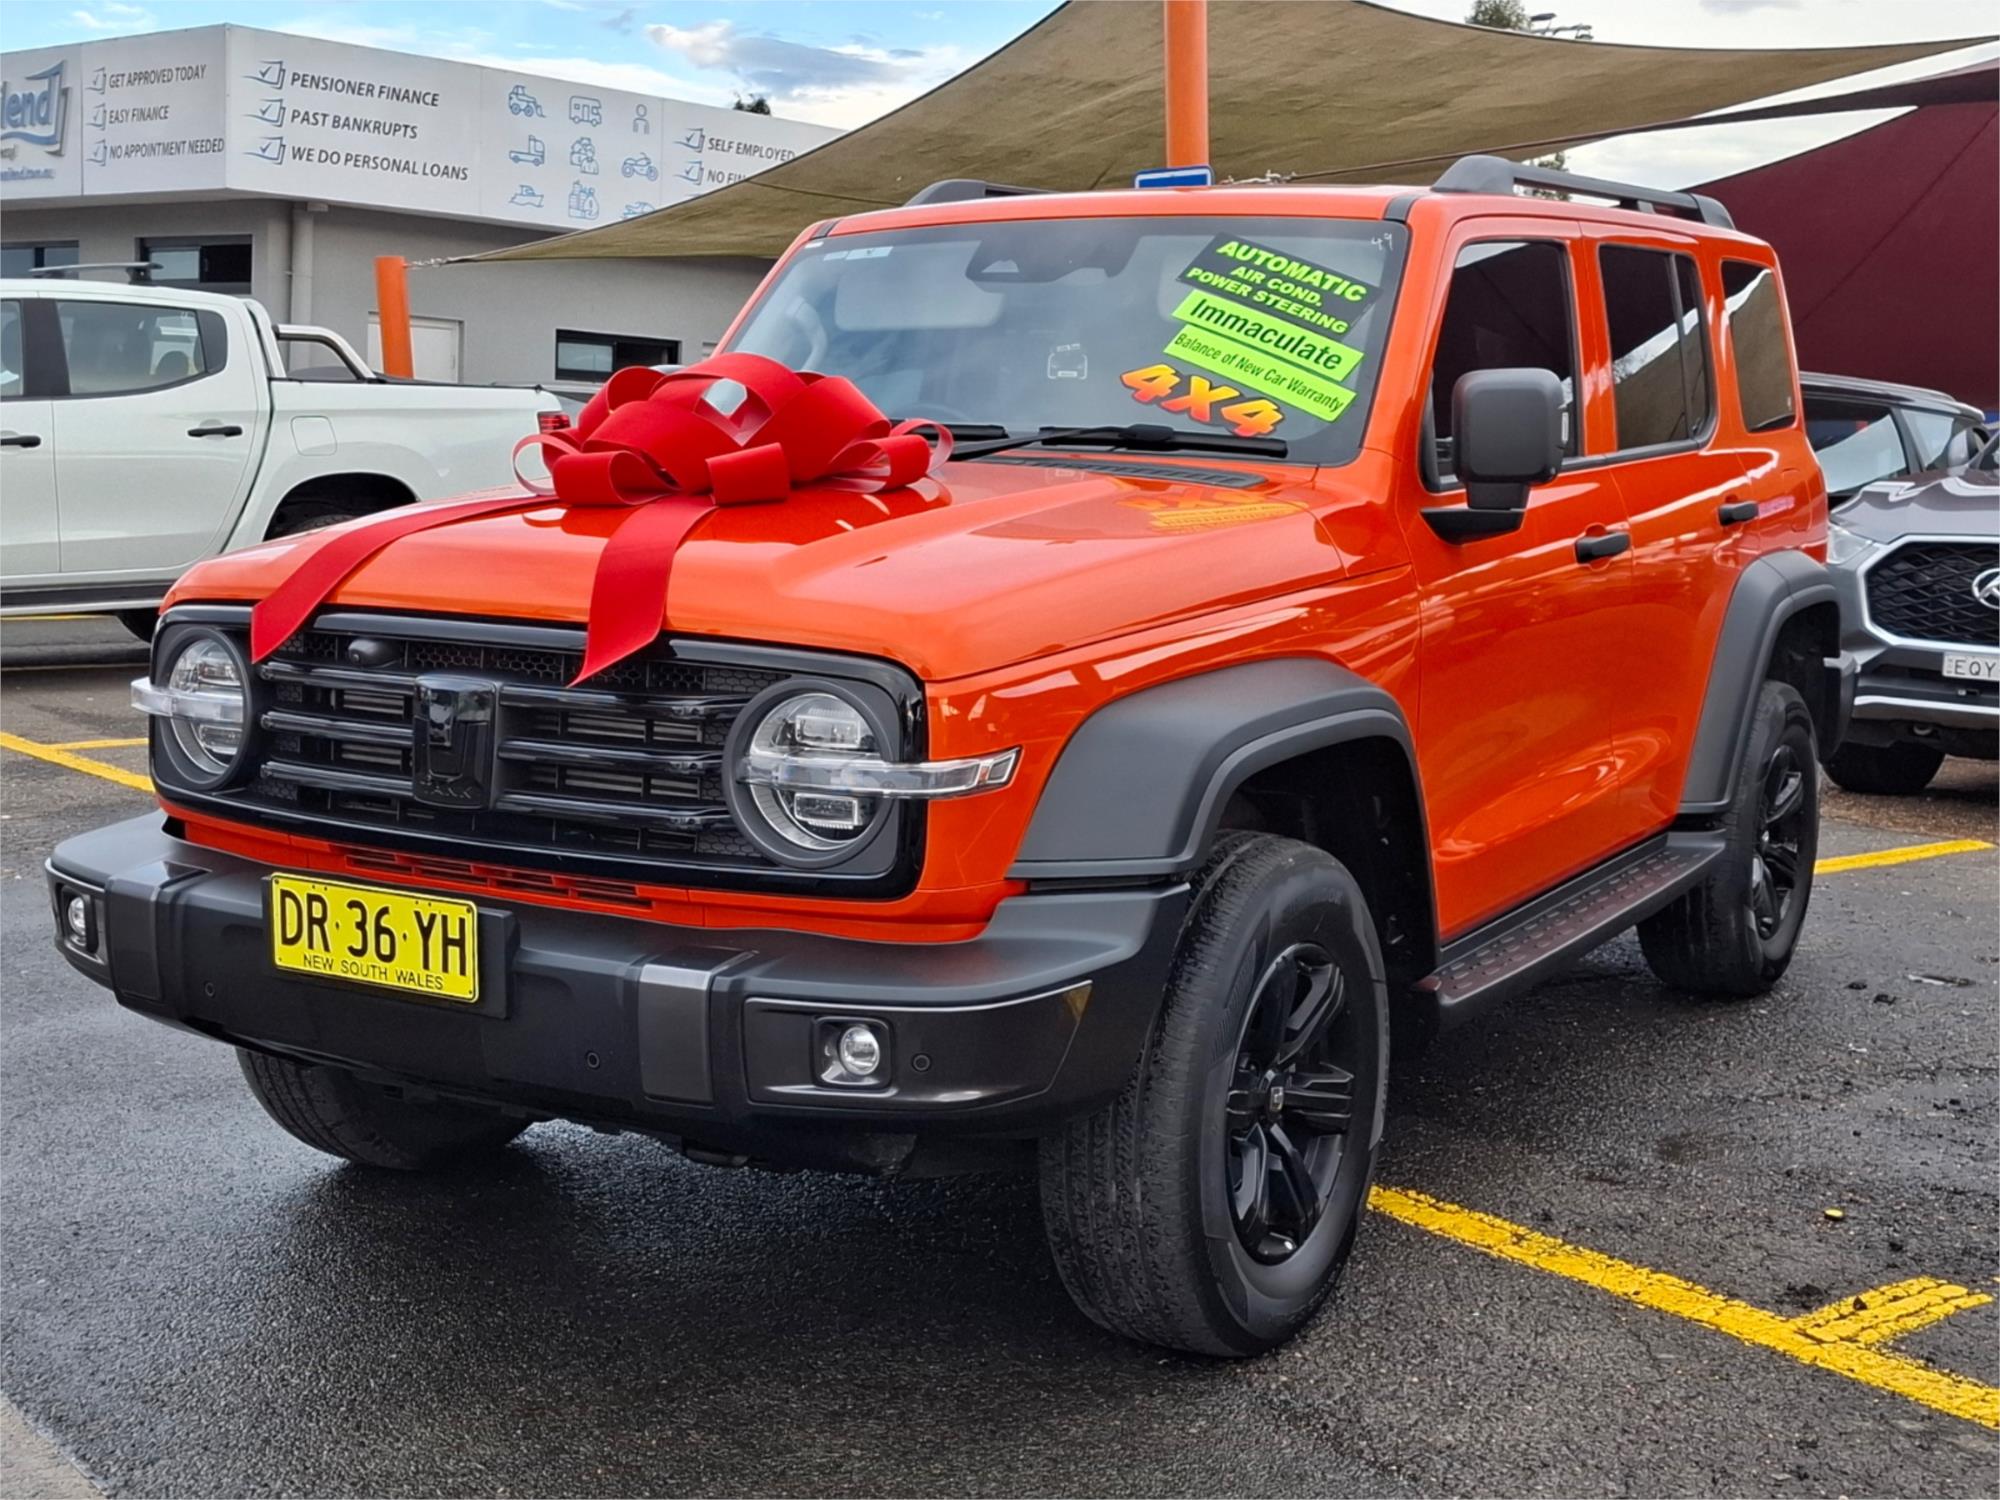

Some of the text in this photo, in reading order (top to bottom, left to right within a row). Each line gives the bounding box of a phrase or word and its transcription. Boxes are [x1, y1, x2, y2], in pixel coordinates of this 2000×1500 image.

[109, 64, 207, 88] GET APPROVED TODAY
[290, 72, 440, 107] PENSIONER FINANCE
[109, 105, 170, 124] EASY FINANCE
[290, 109, 418, 139] PAST BANKRUPTS
[109, 138, 225, 159] NO APPOINTMENT NEEDED
[708, 137, 735, 152] SELF
[291, 145, 469, 181] WE DO PERSONAL LOANS
[707, 169, 725, 183] NO
[1216, 240, 1367, 302] AUTOMATIC
[1230, 266, 1323, 308] AIR COND.
[1186, 267, 1349, 334] POWER STEERING
[1189, 298, 1343, 371] Immaculate
[1174, 333, 1345, 413] Balance of New Car Warranty
[303, 953, 444, 990] NEW SOUTH WALES
